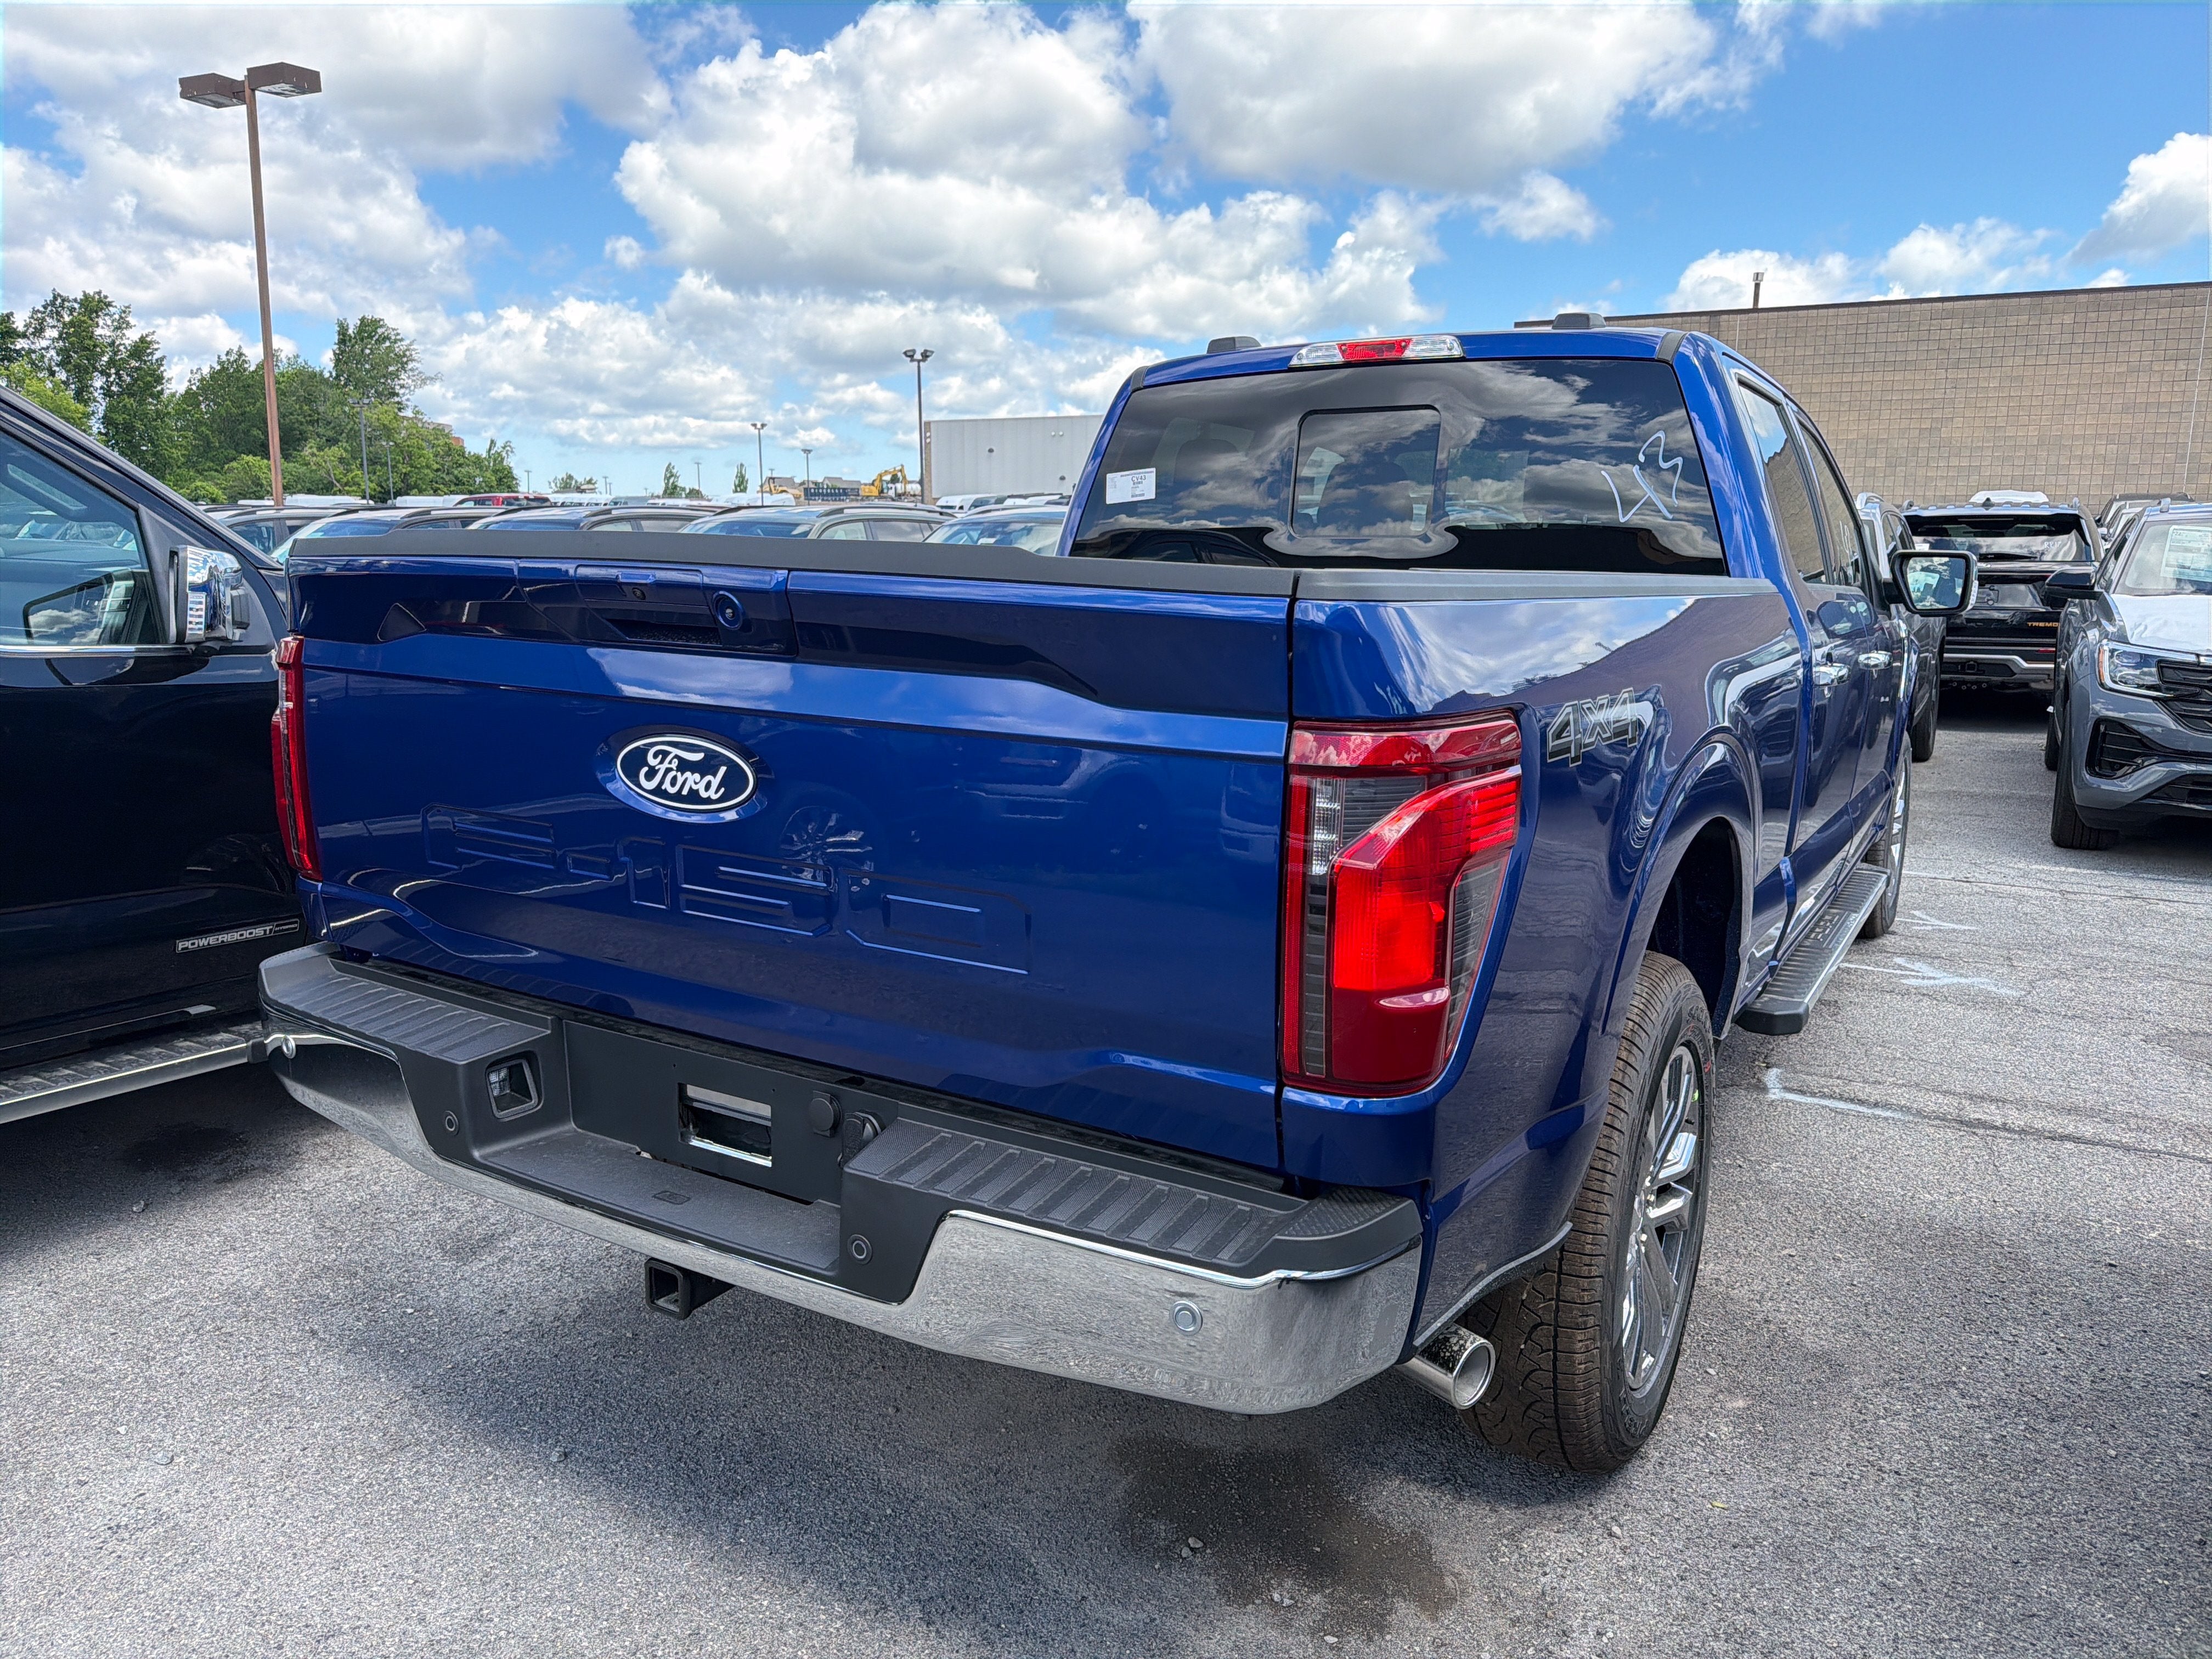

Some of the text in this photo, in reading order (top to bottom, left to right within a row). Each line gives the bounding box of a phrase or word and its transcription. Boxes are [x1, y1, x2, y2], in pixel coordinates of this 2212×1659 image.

[1600, 430, 1683, 523] 43
[639, 745, 727, 800] Ford
[421, 803, 1031, 975] F-150
[178, 926, 273, 951] POWERBOOST
